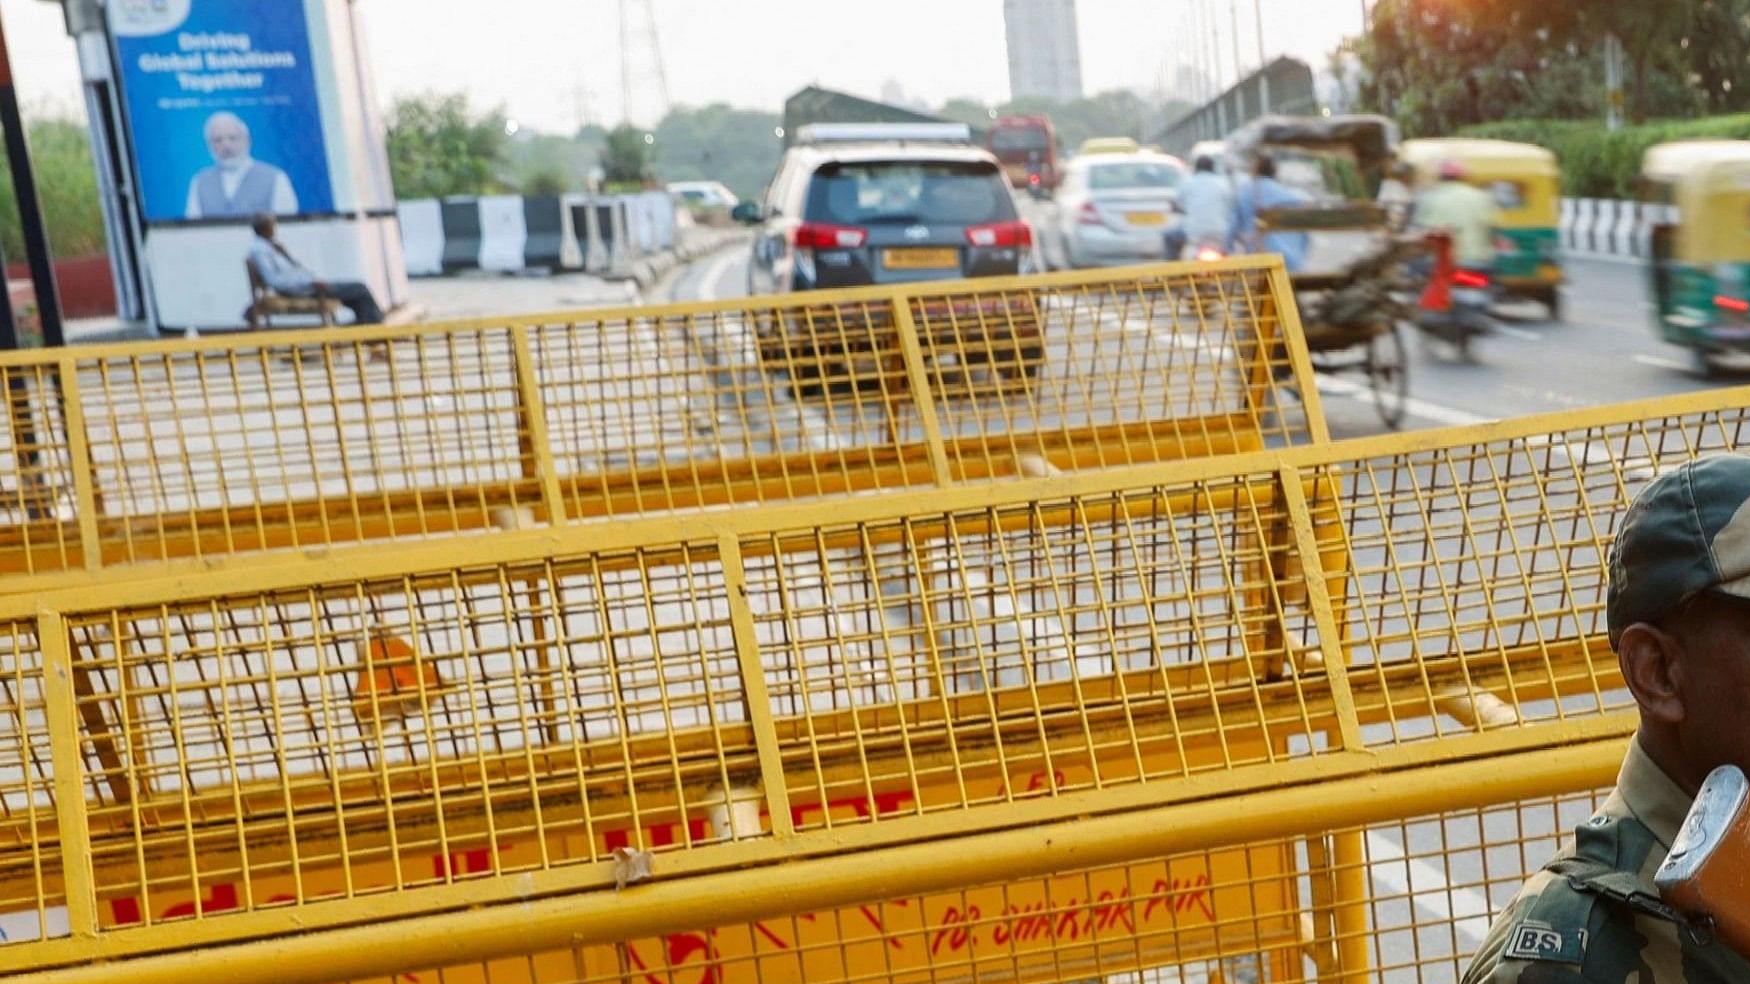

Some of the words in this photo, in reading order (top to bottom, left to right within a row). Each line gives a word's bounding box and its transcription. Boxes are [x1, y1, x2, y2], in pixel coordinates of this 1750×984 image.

[178, 31, 251, 51] Driving
[138, 53, 203, 73] Global
[205, 50, 297, 70] Solutions
[176, 71, 264, 92] Together
